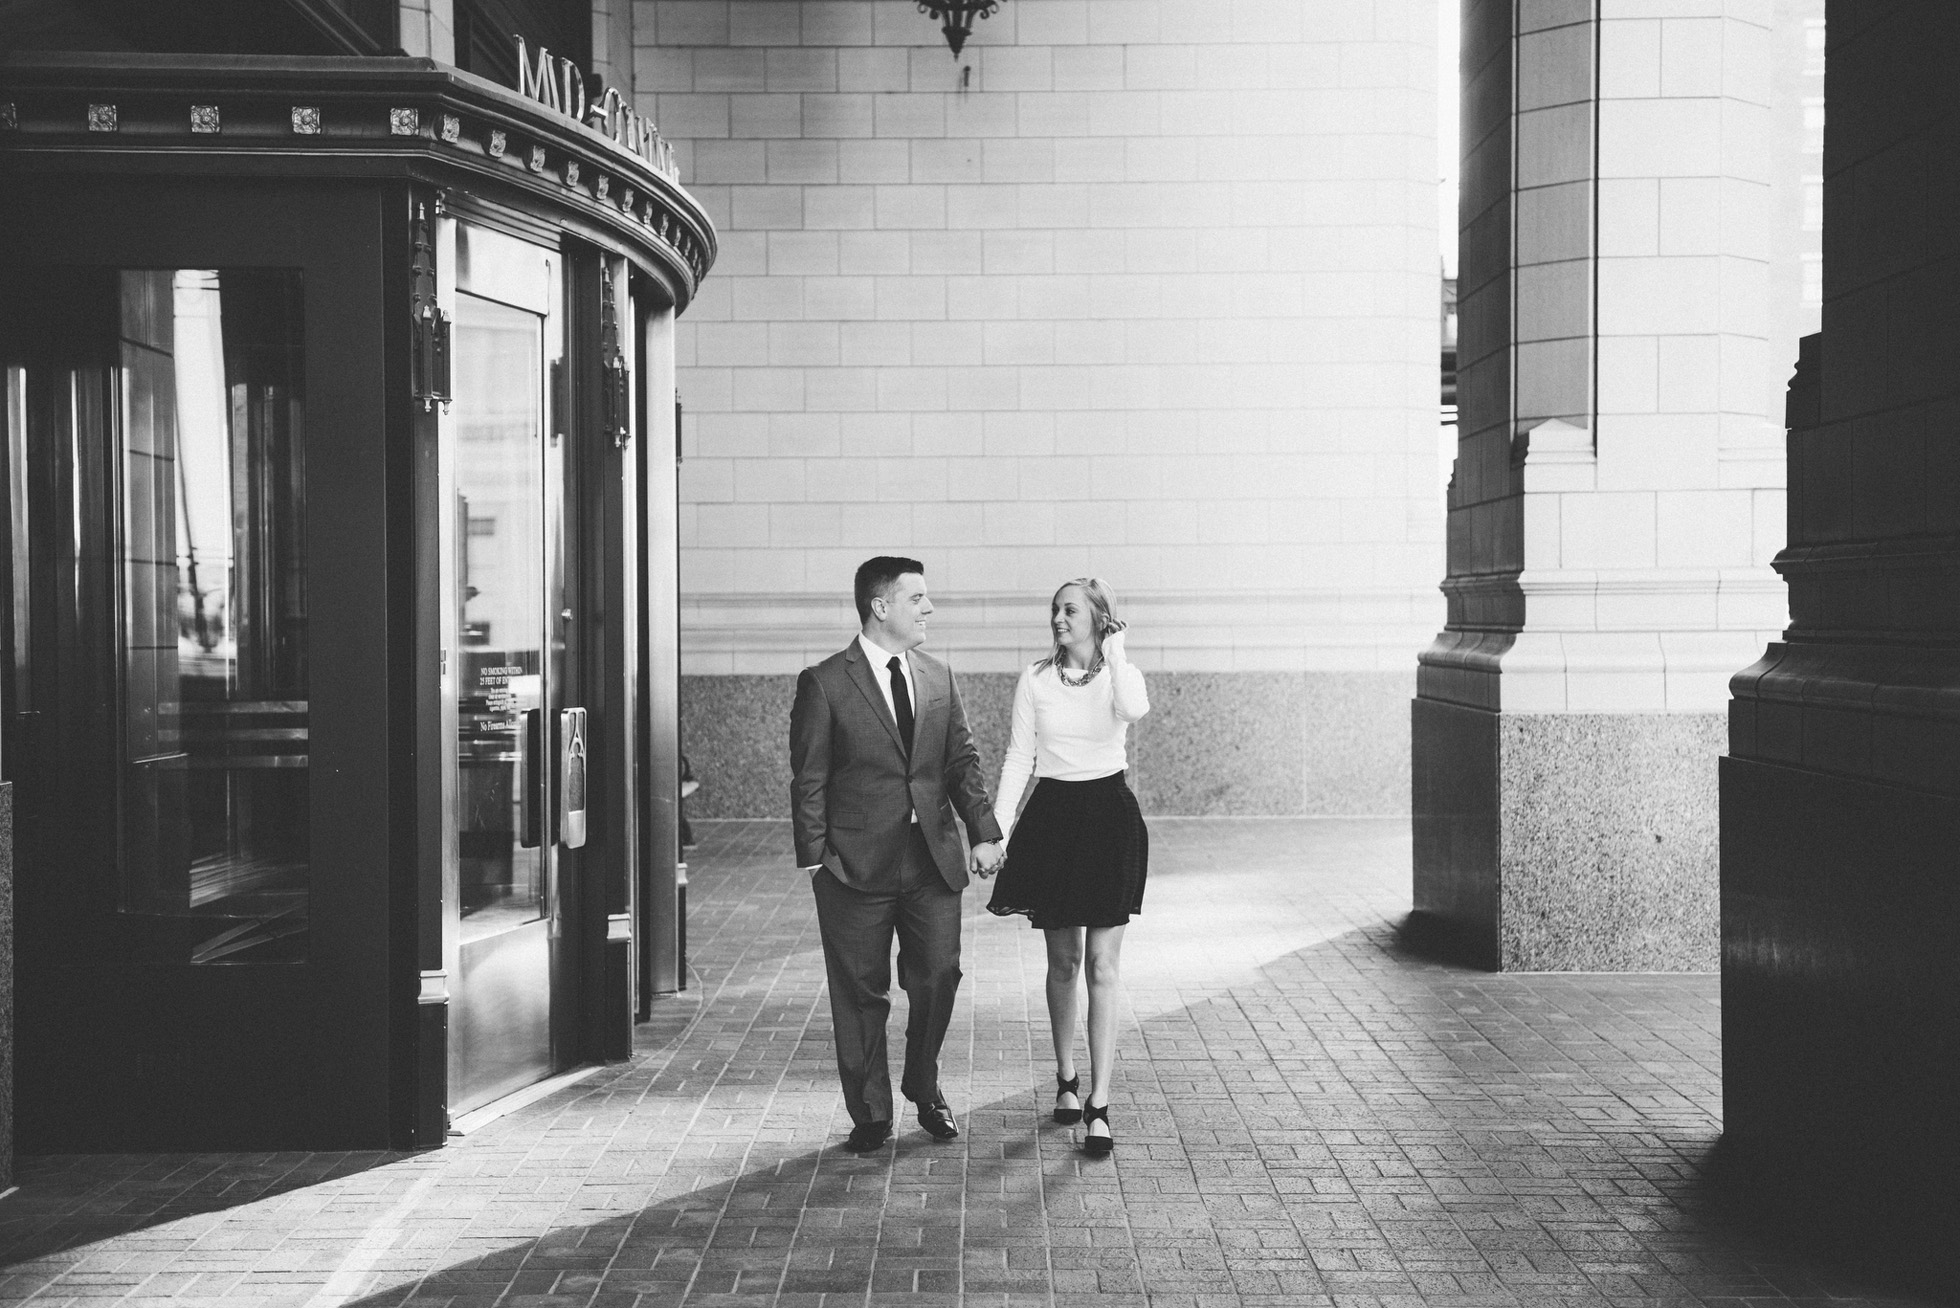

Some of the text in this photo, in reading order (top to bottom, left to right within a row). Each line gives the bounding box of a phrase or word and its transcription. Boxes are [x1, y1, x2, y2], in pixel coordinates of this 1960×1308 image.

[480, 667, 487, 675] NO
[488, 667, 507, 675] SMOKING
[485, 677, 496, 685] FEET
[496, 677, 501, 685] OF
[480, 722, 487, 731] No
